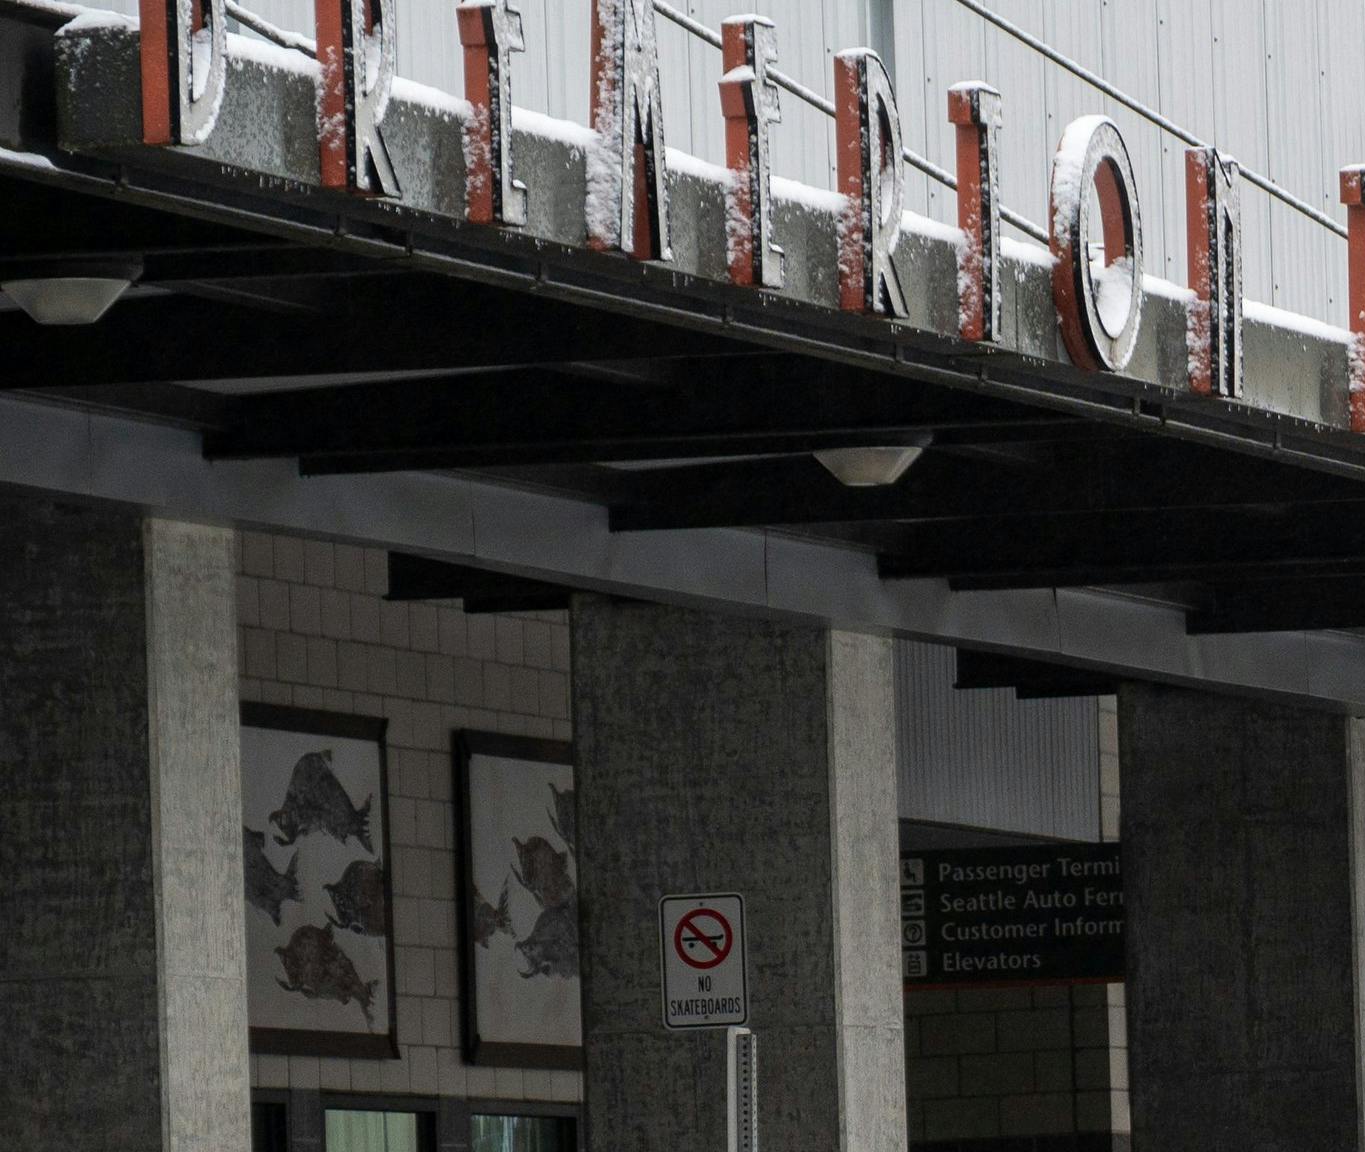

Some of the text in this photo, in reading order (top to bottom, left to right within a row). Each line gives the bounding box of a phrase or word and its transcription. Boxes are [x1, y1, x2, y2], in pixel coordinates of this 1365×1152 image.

[939, 855, 1121, 884] Passenger Termi
[939, 890, 1016, 913] Seattle
[1023, 889, 1077, 909] Auto
[941, 918, 1047, 941] Customer
[943, 951, 1041, 972] Elevators
[698, 975, 712, 993] NO
[670, 997, 741, 1016] SKATEBOARDS
